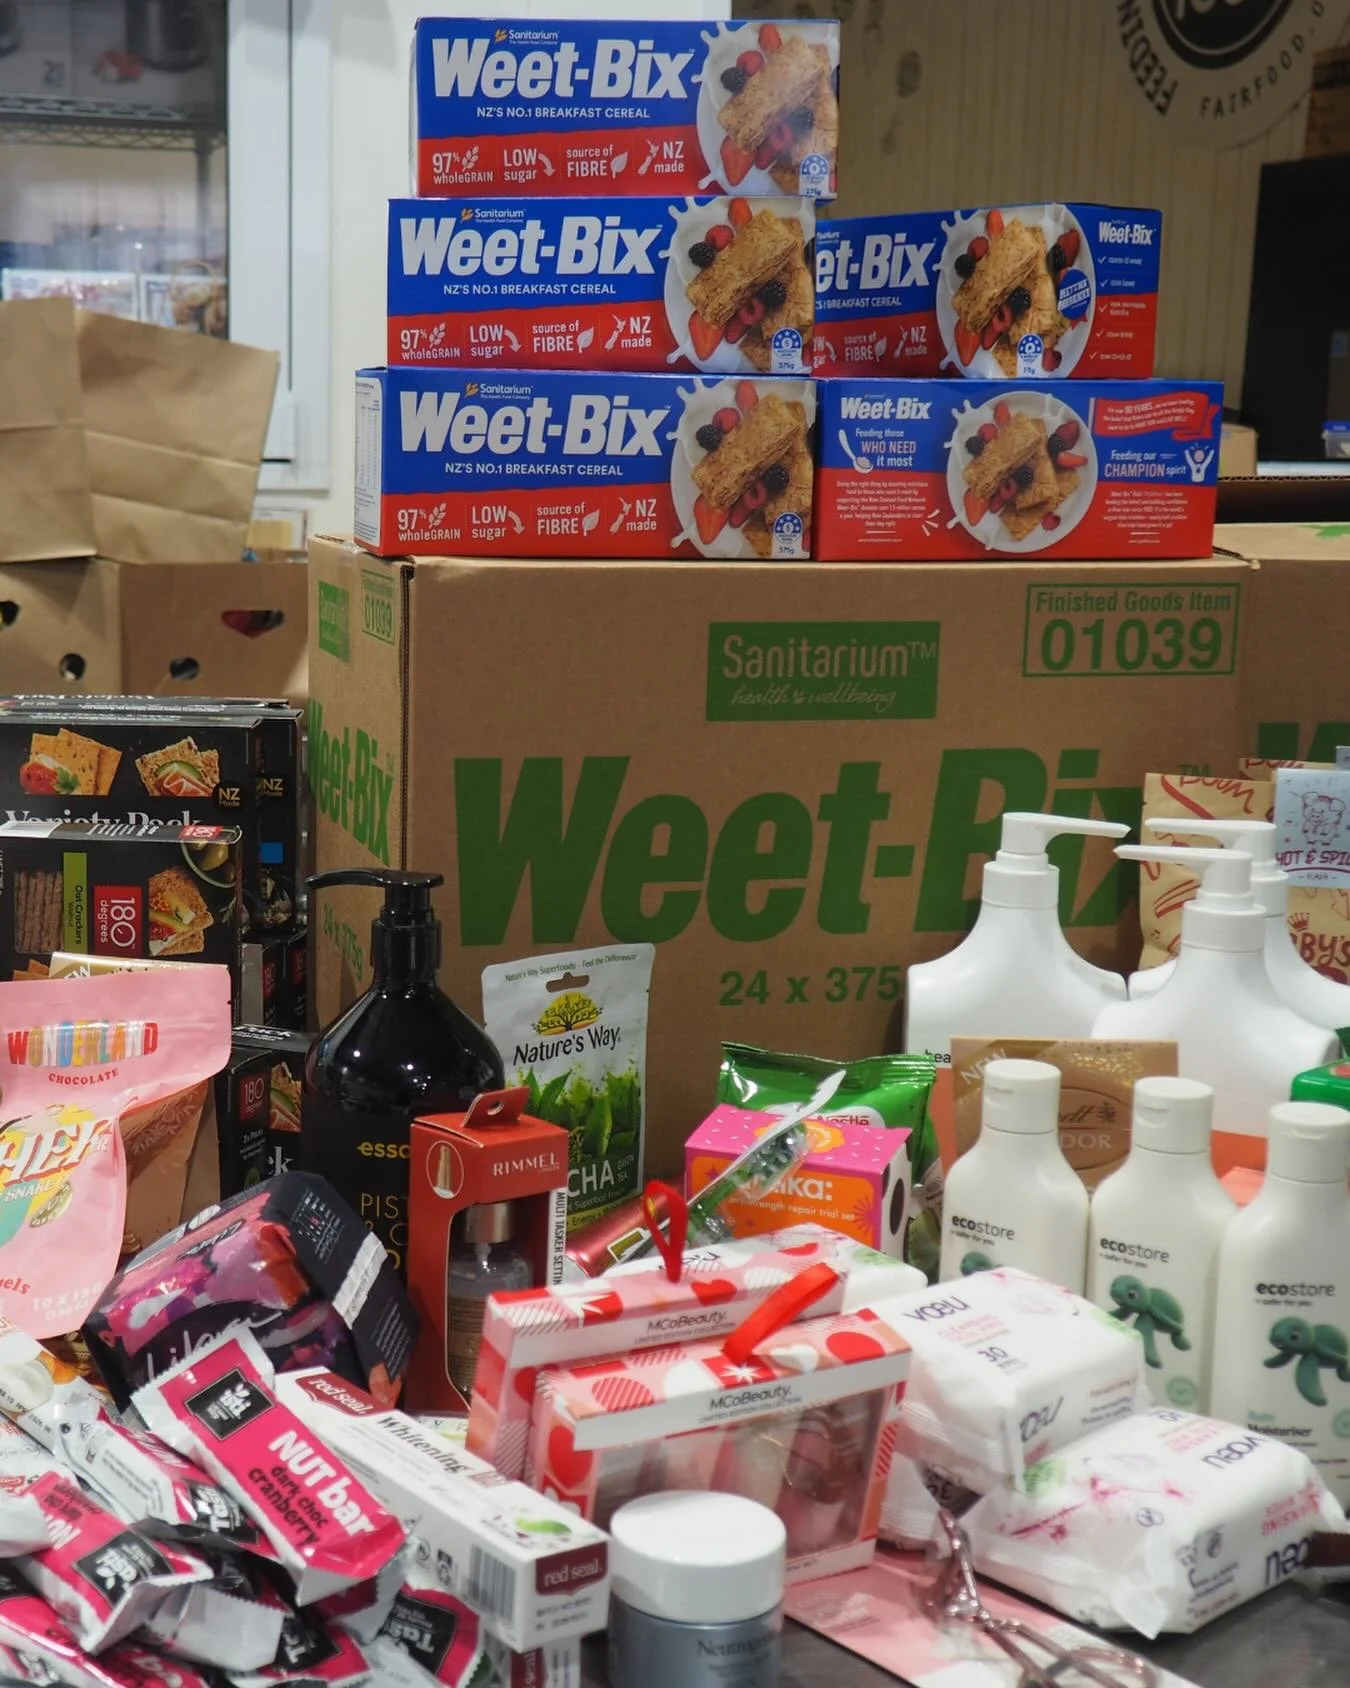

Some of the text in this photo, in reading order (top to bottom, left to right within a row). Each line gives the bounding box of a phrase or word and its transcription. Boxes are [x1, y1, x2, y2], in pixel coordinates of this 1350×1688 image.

[508, 29, 559, 39] Sanitarium
[432, 38, 694, 98] Weet-Bix
[477, 107, 650, 119] NZ'S NO.1 BREAKFAST CEREAL
[503, 148, 537, 167] LOW
[566, 145, 614, 159] source of
[663, 141, 684, 159] NZ
[432, 152, 460, 174] 97%
[567, 160, 607, 178] FIBRE
[654, 161, 685, 174] made
[433, 172, 493, 185] wholeGRAIN
[503, 169, 537, 184] sugar
[474, 208, 525, 218] Sanitarium
[1099, 221, 1153, 245] Weet-Bix
[400, 216, 662, 276] Weet-Bix
[443, 284, 616, 295] NZ'S NO.1 BREAKFAST CEREAL
[469, 324, 504, 343] LOW
[532, 319, 579, 334] source of
[630, 315, 652, 334] NZ
[400, 328, 427, 349] 97%
[621, 335, 652, 349] made
[911, 326, 927, 343] NZ
[470, 344, 504, 359] sugar
[533, 335, 574, 353] FIBRE
[401, 347, 461, 360] wholeGRAIN
[845, 345, 874, 362] FIBRE
[480, 384, 531, 395] Sanitarium
[840, 397, 932, 420] Weet-Bix
[400, 391, 670, 456] Weet-Bix
[856, 428, 904, 438] Feeding those
[861, 441, 917, 454] WHO NEED
[1111, 449, 1157, 462] Feeding our
[445, 463, 623, 476] NZ'S NO.1 BREAKFAST CEREAL
[877, 455, 912, 467] it most
[1104, 463, 1186, 478] CHAMPION spirit
[472, 505, 507, 524] LOW
[537, 502, 586, 516] source of
[635, 499, 657, 517] NZ
[398, 508, 427, 530] 97%
[537, 517, 578, 535] FIBRE
[626, 519, 657, 532] made
[399, 528, 460, 542] wholeGRAIN
[472, 526, 507, 541] sugar
[1036, 591, 1231, 613] Finished Goods Item
[1041, 617, 1222, 672] 01039
[722, 634, 909, 678] Sanitarium
[808, 681, 896, 713] wellbeing
[218, 787, 240, 801] NZ
[97, 899, 110, 943] degrees
[110, 897, 136, 948] 180
[720, 971, 768, 1006] 24
[786, 978, 808, 1004] x
[7, 1019, 158, 1068] WONDERLAND
[513, 1025, 621, 1066] Nature's Way
[48, 1068, 119, 1085] CHOCOLATE
[493, 1152, 560, 1177] RIMMEL
[555, 1192, 566, 1217] MULTI
[788, 1204, 817, 1216] repair
[820, 1208, 839, 1221] trial
[554, 1220, 565, 1251] TASKER
[951, 1214, 1016, 1241] ecostore
[1100, 1236, 1170, 1263] ecostore
[1256, 1282, 1336, 1297] ecostore
[307, 1379, 332, 1397] red
[376, 1416, 473, 1475] Whitening
[268, 1430, 375, 1537] NUT bar
[271, 1464, 329, 1528] dark choc
[247, 1467, 320, 1545] cranberry
[544, 1565, 569, 1587] red
